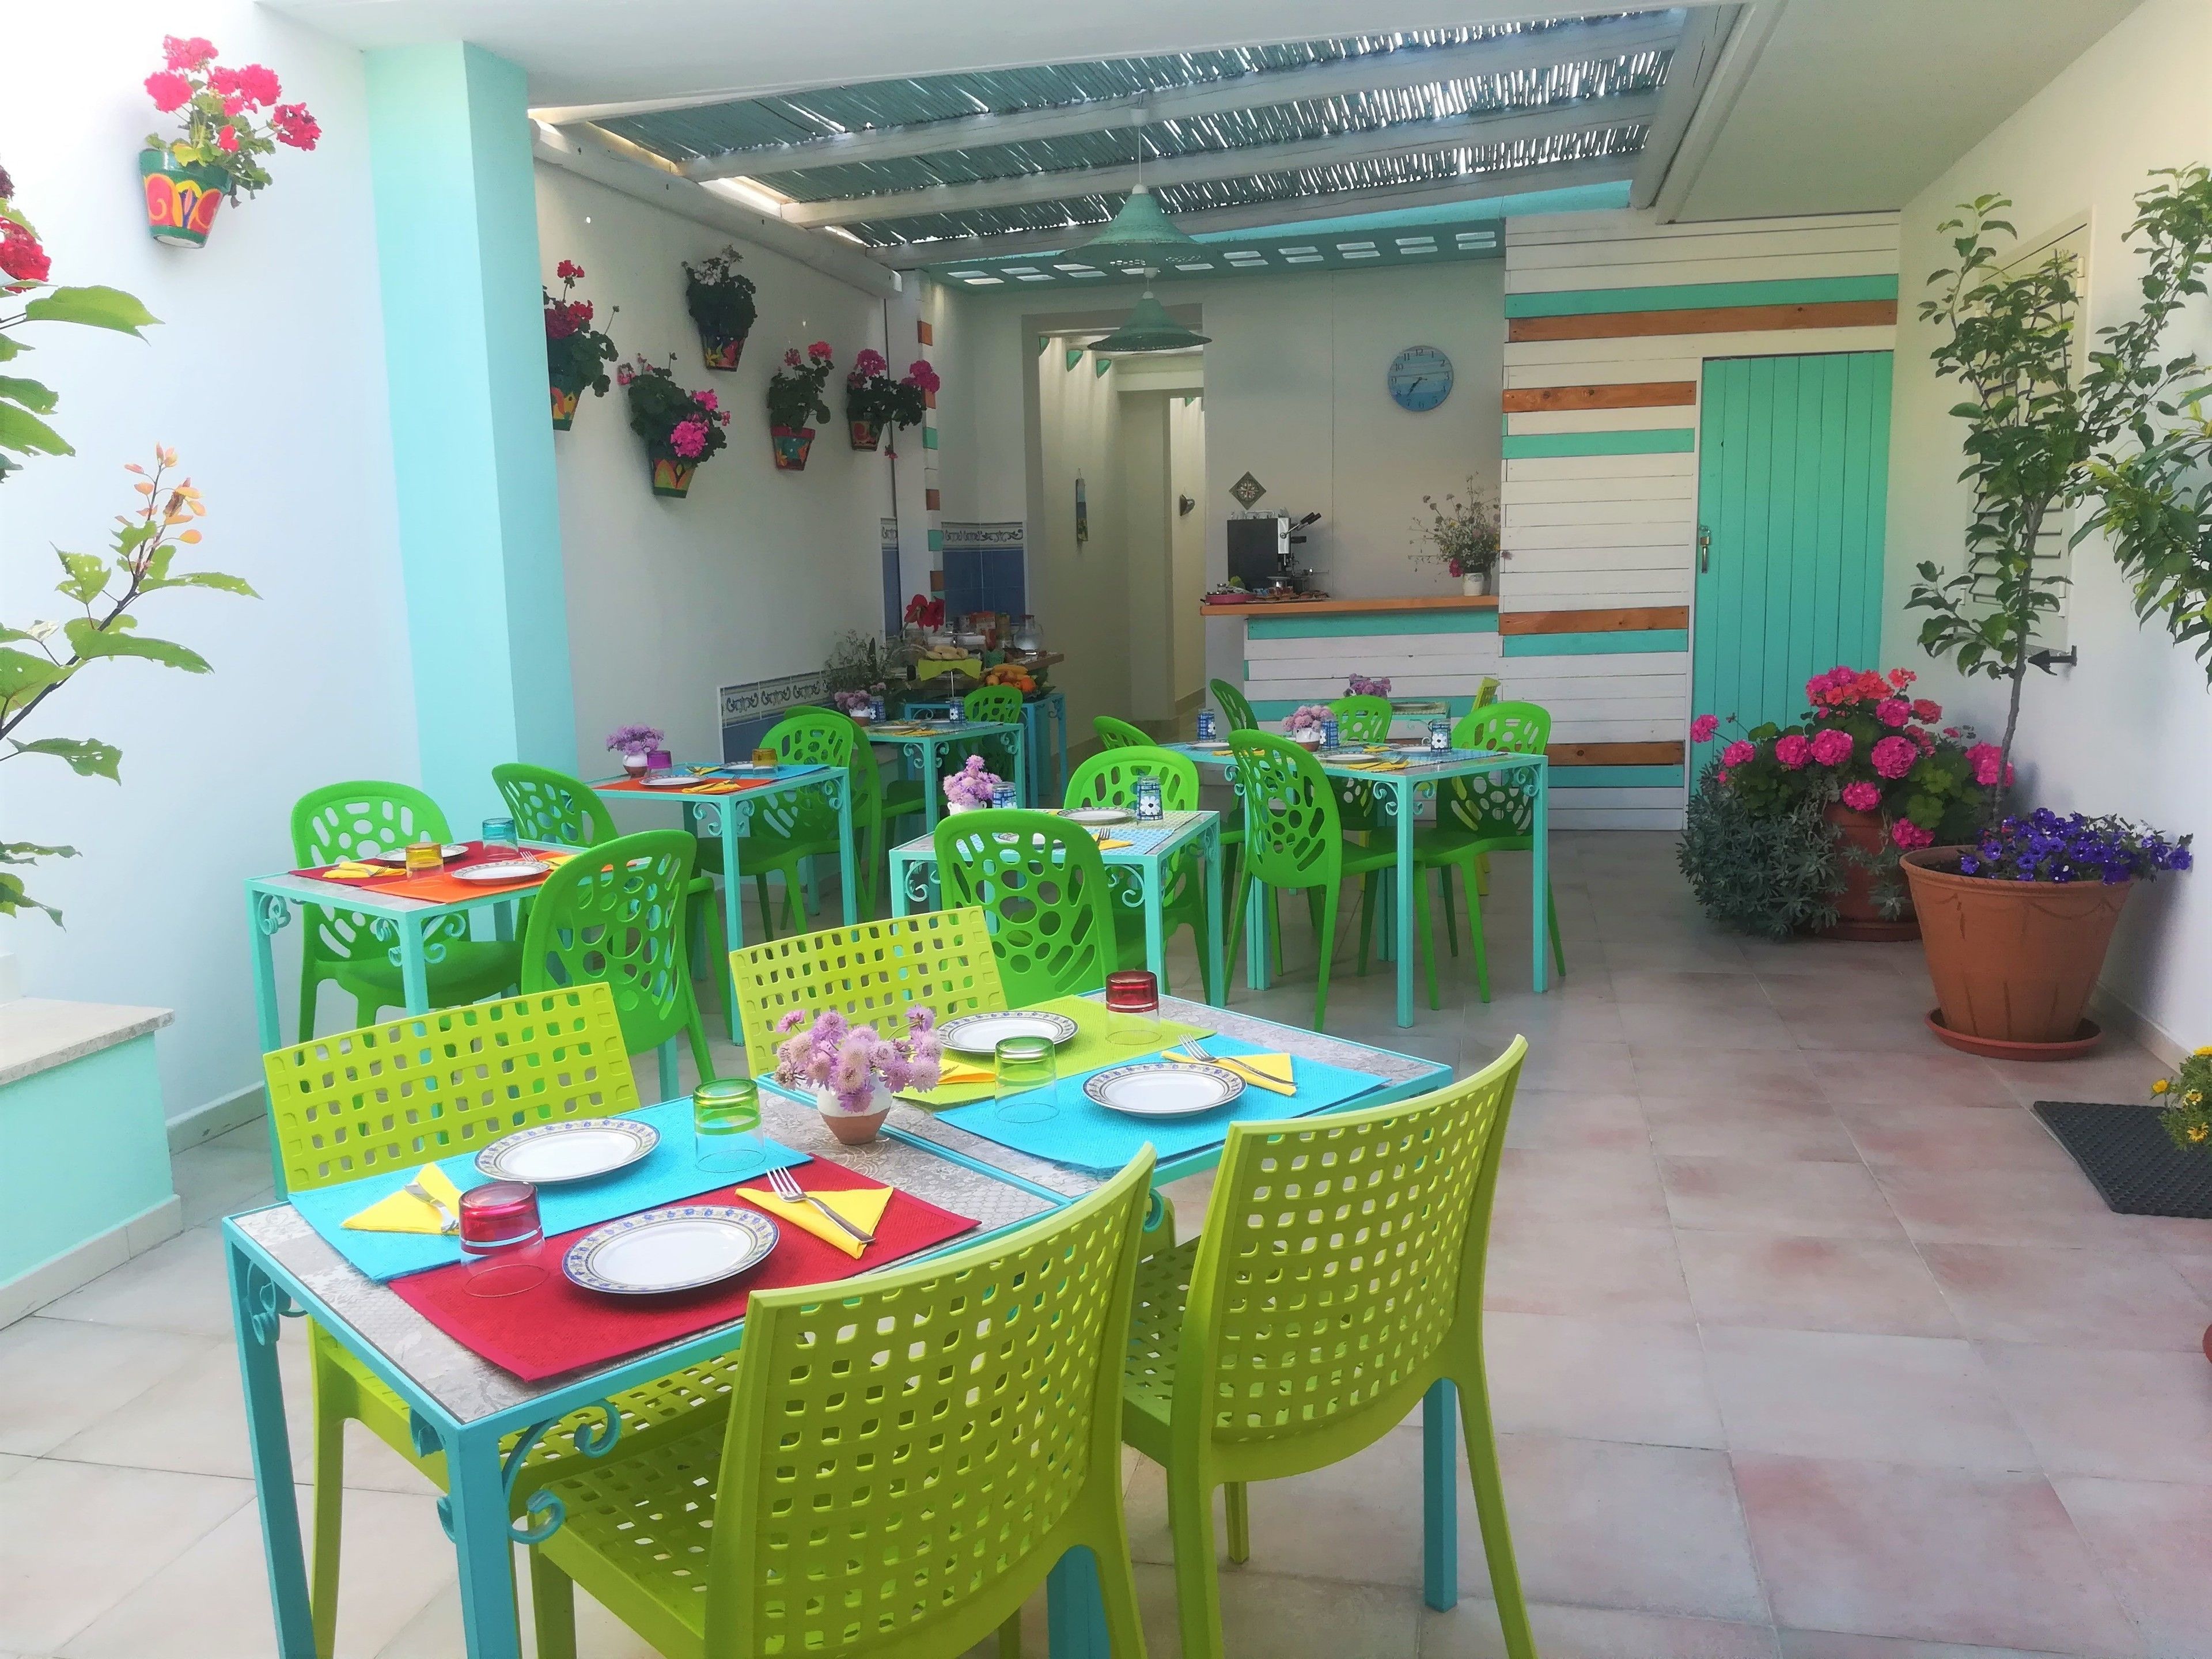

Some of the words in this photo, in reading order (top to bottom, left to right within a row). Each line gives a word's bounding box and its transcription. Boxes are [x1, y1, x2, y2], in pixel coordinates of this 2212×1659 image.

[1404, 353, 1410, 361] 11
[1431, 350, 1434, 358] 1
[1395, 362, 1404, 372] 10
[1444, 371, 1450, 380] 3
[1407, 399, 1412, 407] 7
